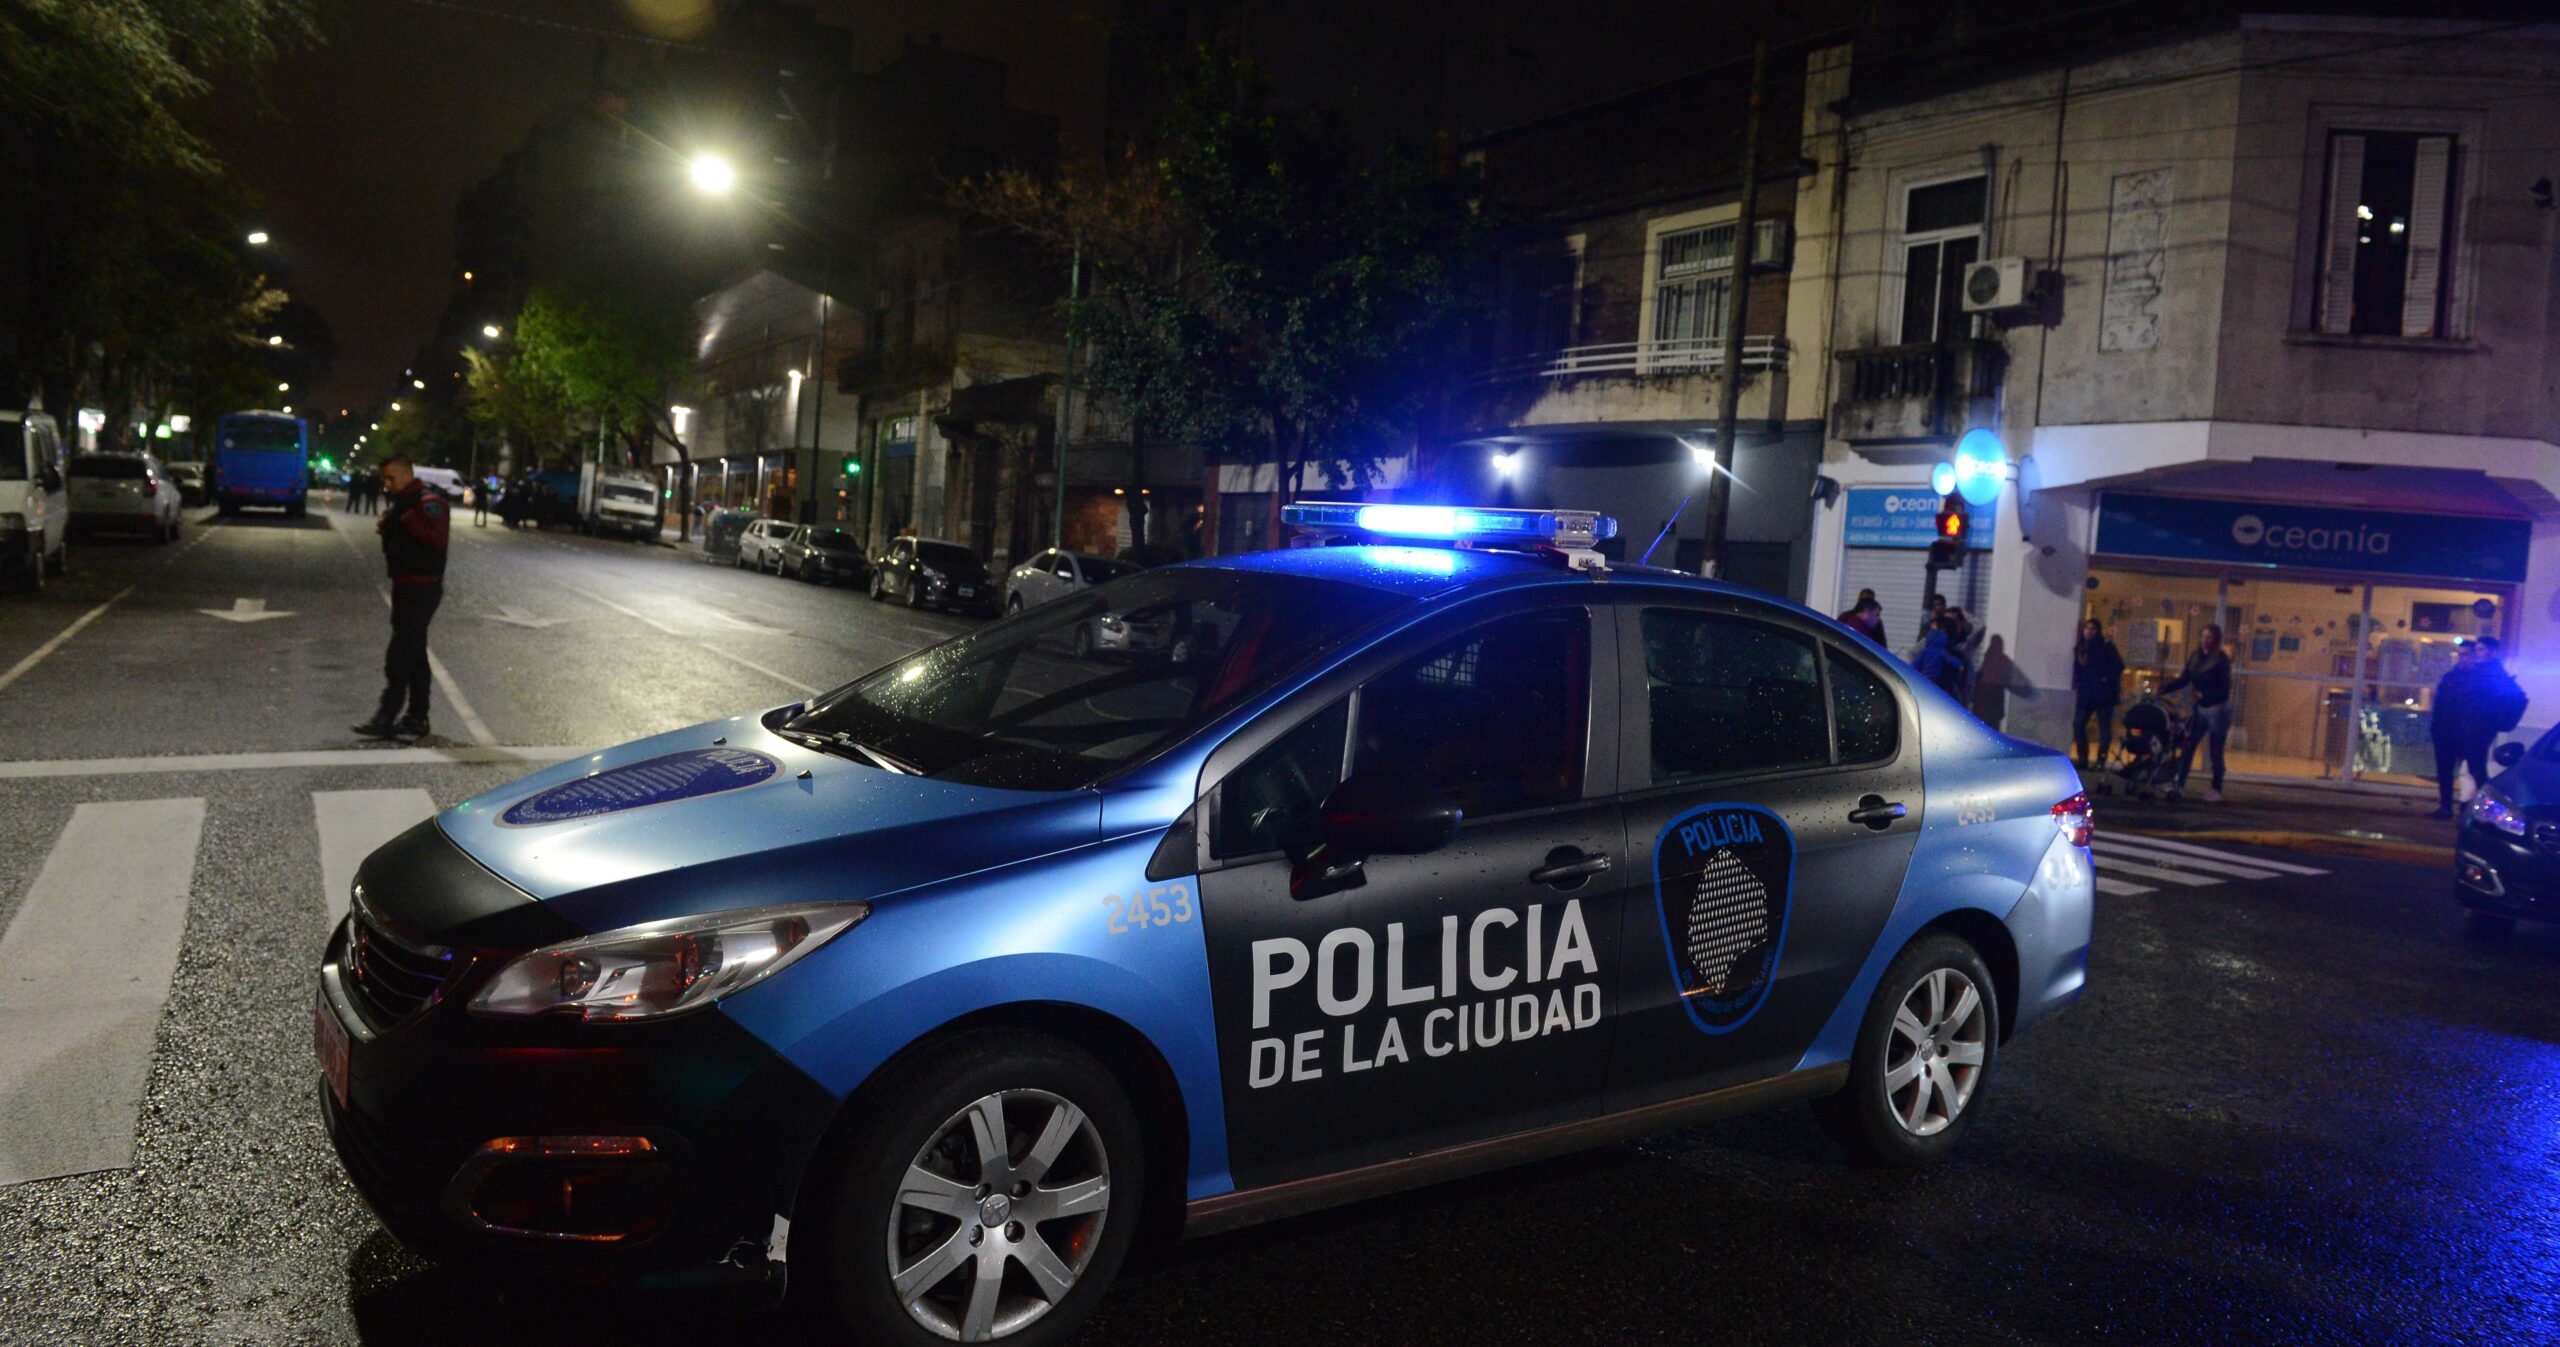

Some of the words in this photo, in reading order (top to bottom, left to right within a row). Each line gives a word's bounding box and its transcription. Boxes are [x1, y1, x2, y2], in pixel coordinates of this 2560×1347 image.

[2232, 514, 2391, 555] Oceanía
[1681, 814, 1764, 857] POLICIA
[1103, 884, 1192, 935] 2453
[1251, 899, 1599, 1029] POLICIA
[1249, 1030, 1325, 1089] DE
[1342, 1016, 1410, 1073] LA
[1423, 983, 1601, 1058] CIUDAD
